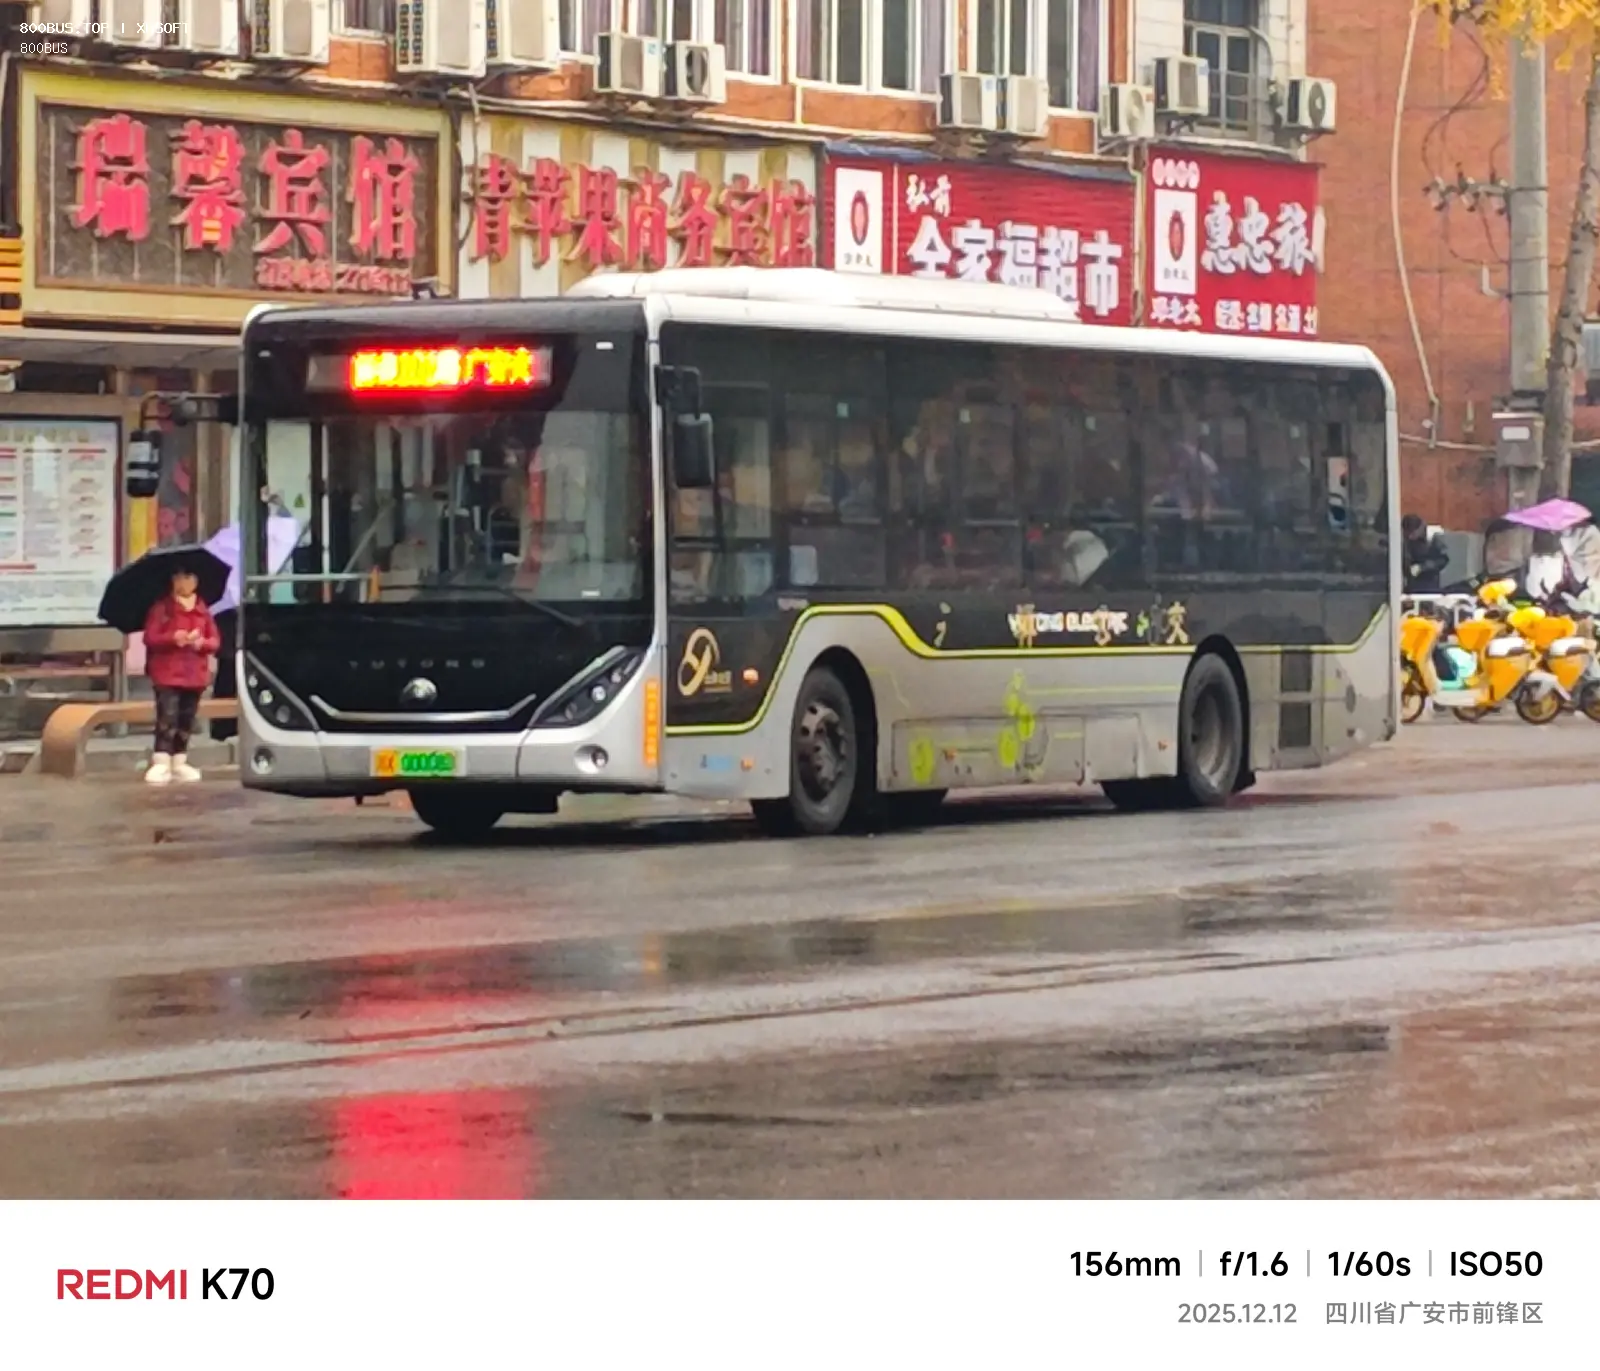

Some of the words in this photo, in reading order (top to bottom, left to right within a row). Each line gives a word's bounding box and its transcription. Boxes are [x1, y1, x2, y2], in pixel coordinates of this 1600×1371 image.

[69, 112, 421, 260] 瑞馨宾馆
[463, 152, 815, 270] 青苹果商务宾馆
[905, 215, 1123, 317] 全家福超市
